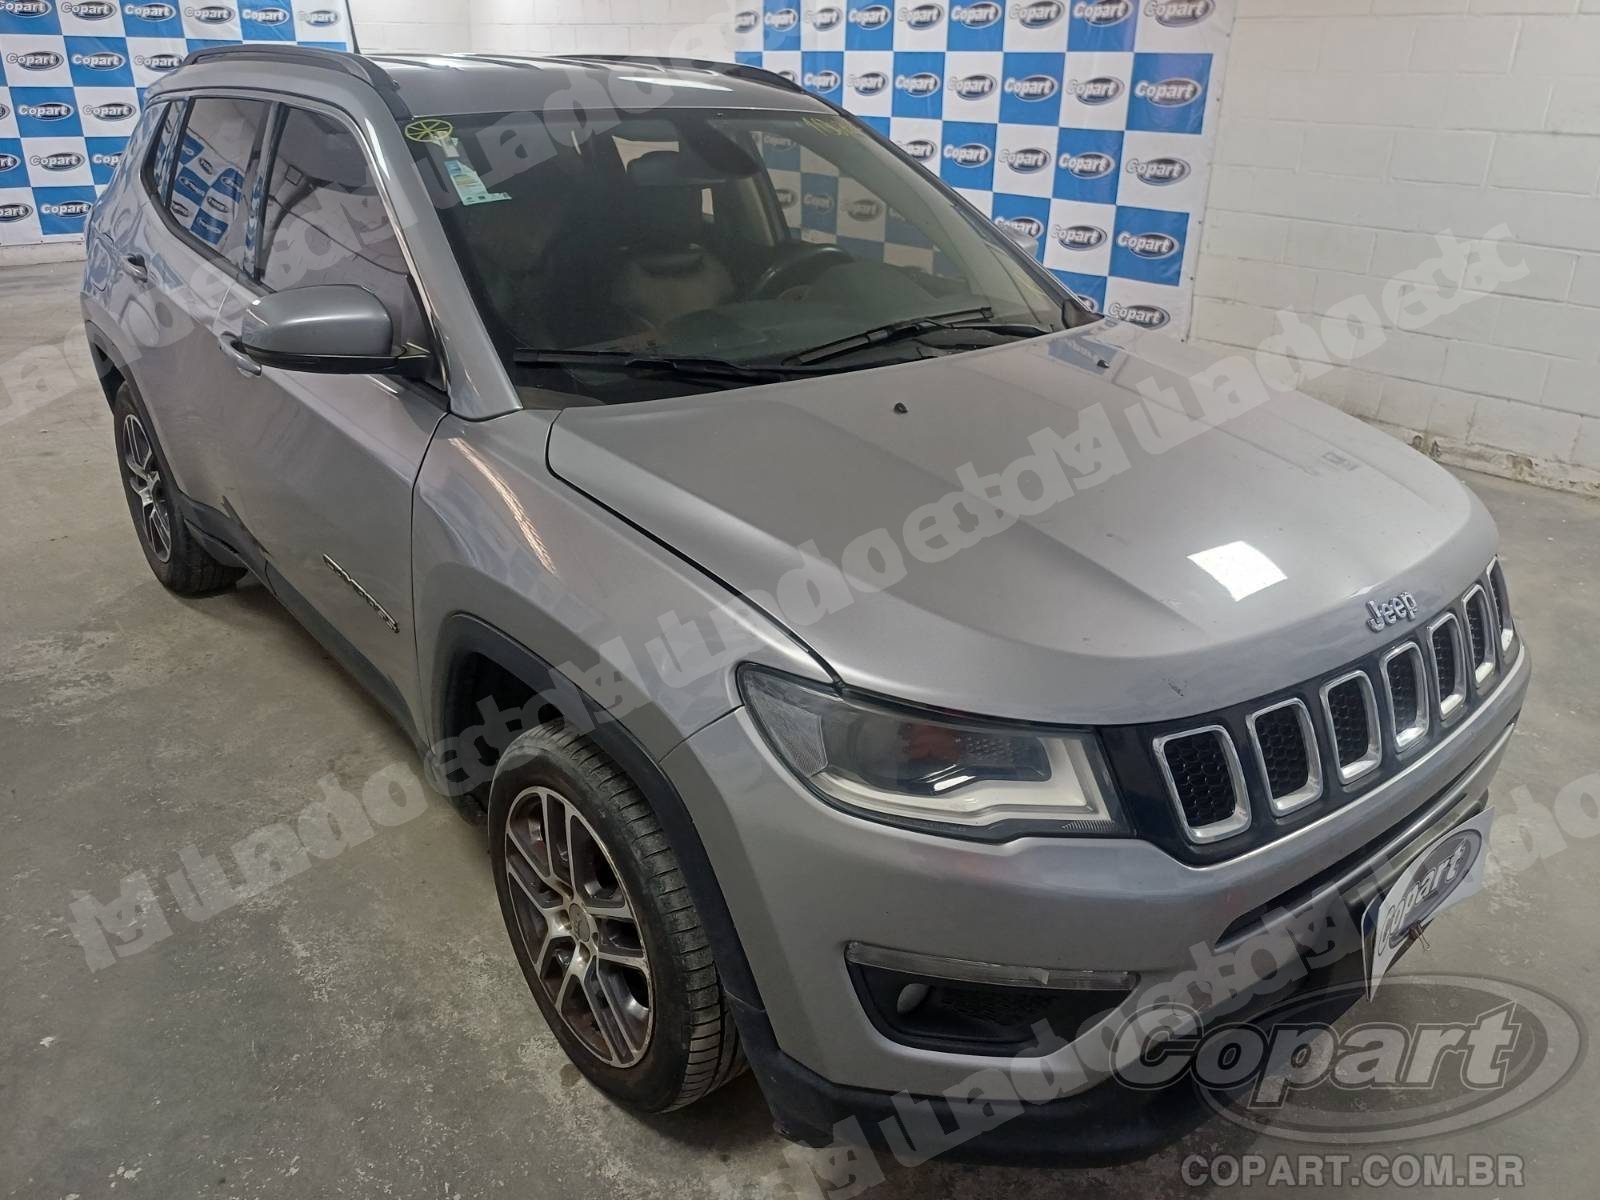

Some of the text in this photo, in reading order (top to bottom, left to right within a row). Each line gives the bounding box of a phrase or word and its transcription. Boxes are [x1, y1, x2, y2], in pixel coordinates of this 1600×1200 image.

[61, 2, 110, 14] Copart
[124, 4, 170, 18] Copart
[184, 6, 229, 19] Copart
[242, 8, 284, 22] Copart
[848, 8, 886, 26] Copart
[898, 6, 938, 24] Copart
[951, 5, 995, 23] Copart
[1009, 3, 1058, 22] Copart
[1073, 1, 1126, 21] Copart
[1143, 0, 1205, 20] Copart
[6, 52, 56, 67] Copart
[72, 53, 120, 68] Copart
[134, 55, 179, 67] Copart
[895, 74, 936, 92] Copart
[947, 76, 989, 95] Copart
[1004, 77, 1052, 97] Copart
[1066, 79, 1116, 99] Copart
[1135, 81, 1195, 101] Copart
[18, 104, 68, 118] Copart
[82, 104, 129, 117] Copart
[30, 155, 78, 168] Copart
[92, 154, 120, 166] Cop
[944, 143, 987, 162] Copart
[999, 148, 1043, 167] Copart
[1059, 152, 1107, 172] Copart
[1126, 158, 1182, 179] Copart
[42, 203, 89, 217] Copart
[1053, 224, 1097, 244] Copart
[1117, 231, 1170, 252] Copart
[1109, 302, 1162, 325] Copart
[1366, 592, 1416, 632] Jeep
[1378, 837, 1467, 956] Copart
